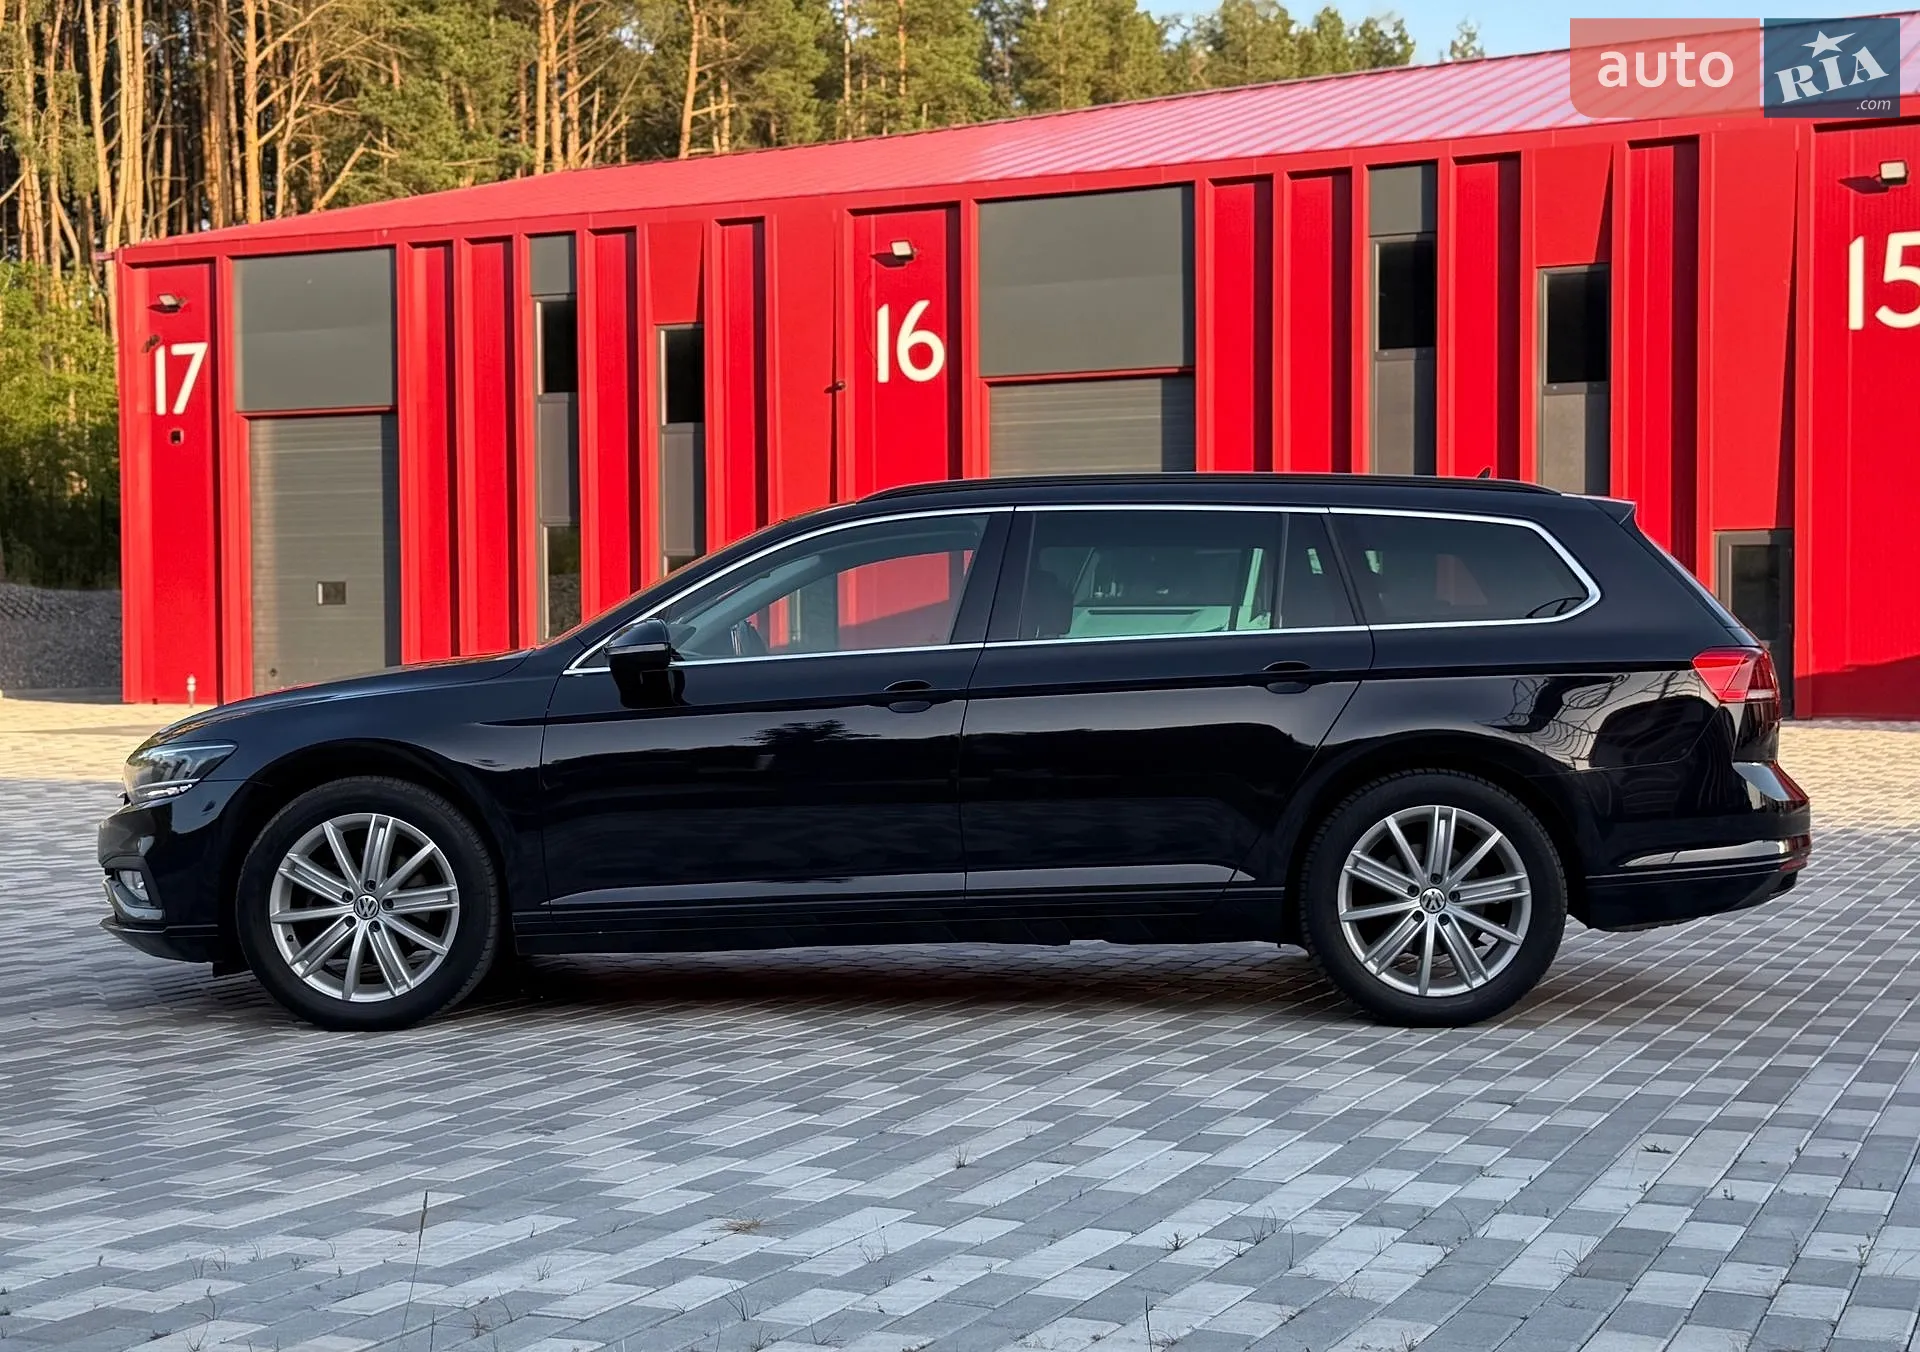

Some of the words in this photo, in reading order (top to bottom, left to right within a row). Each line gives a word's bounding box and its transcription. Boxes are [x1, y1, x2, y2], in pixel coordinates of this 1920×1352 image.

[1848, 230, 1920, 330] 15
[155, 342, 209, 416] 17
[877, 299, 946, 384] 16
